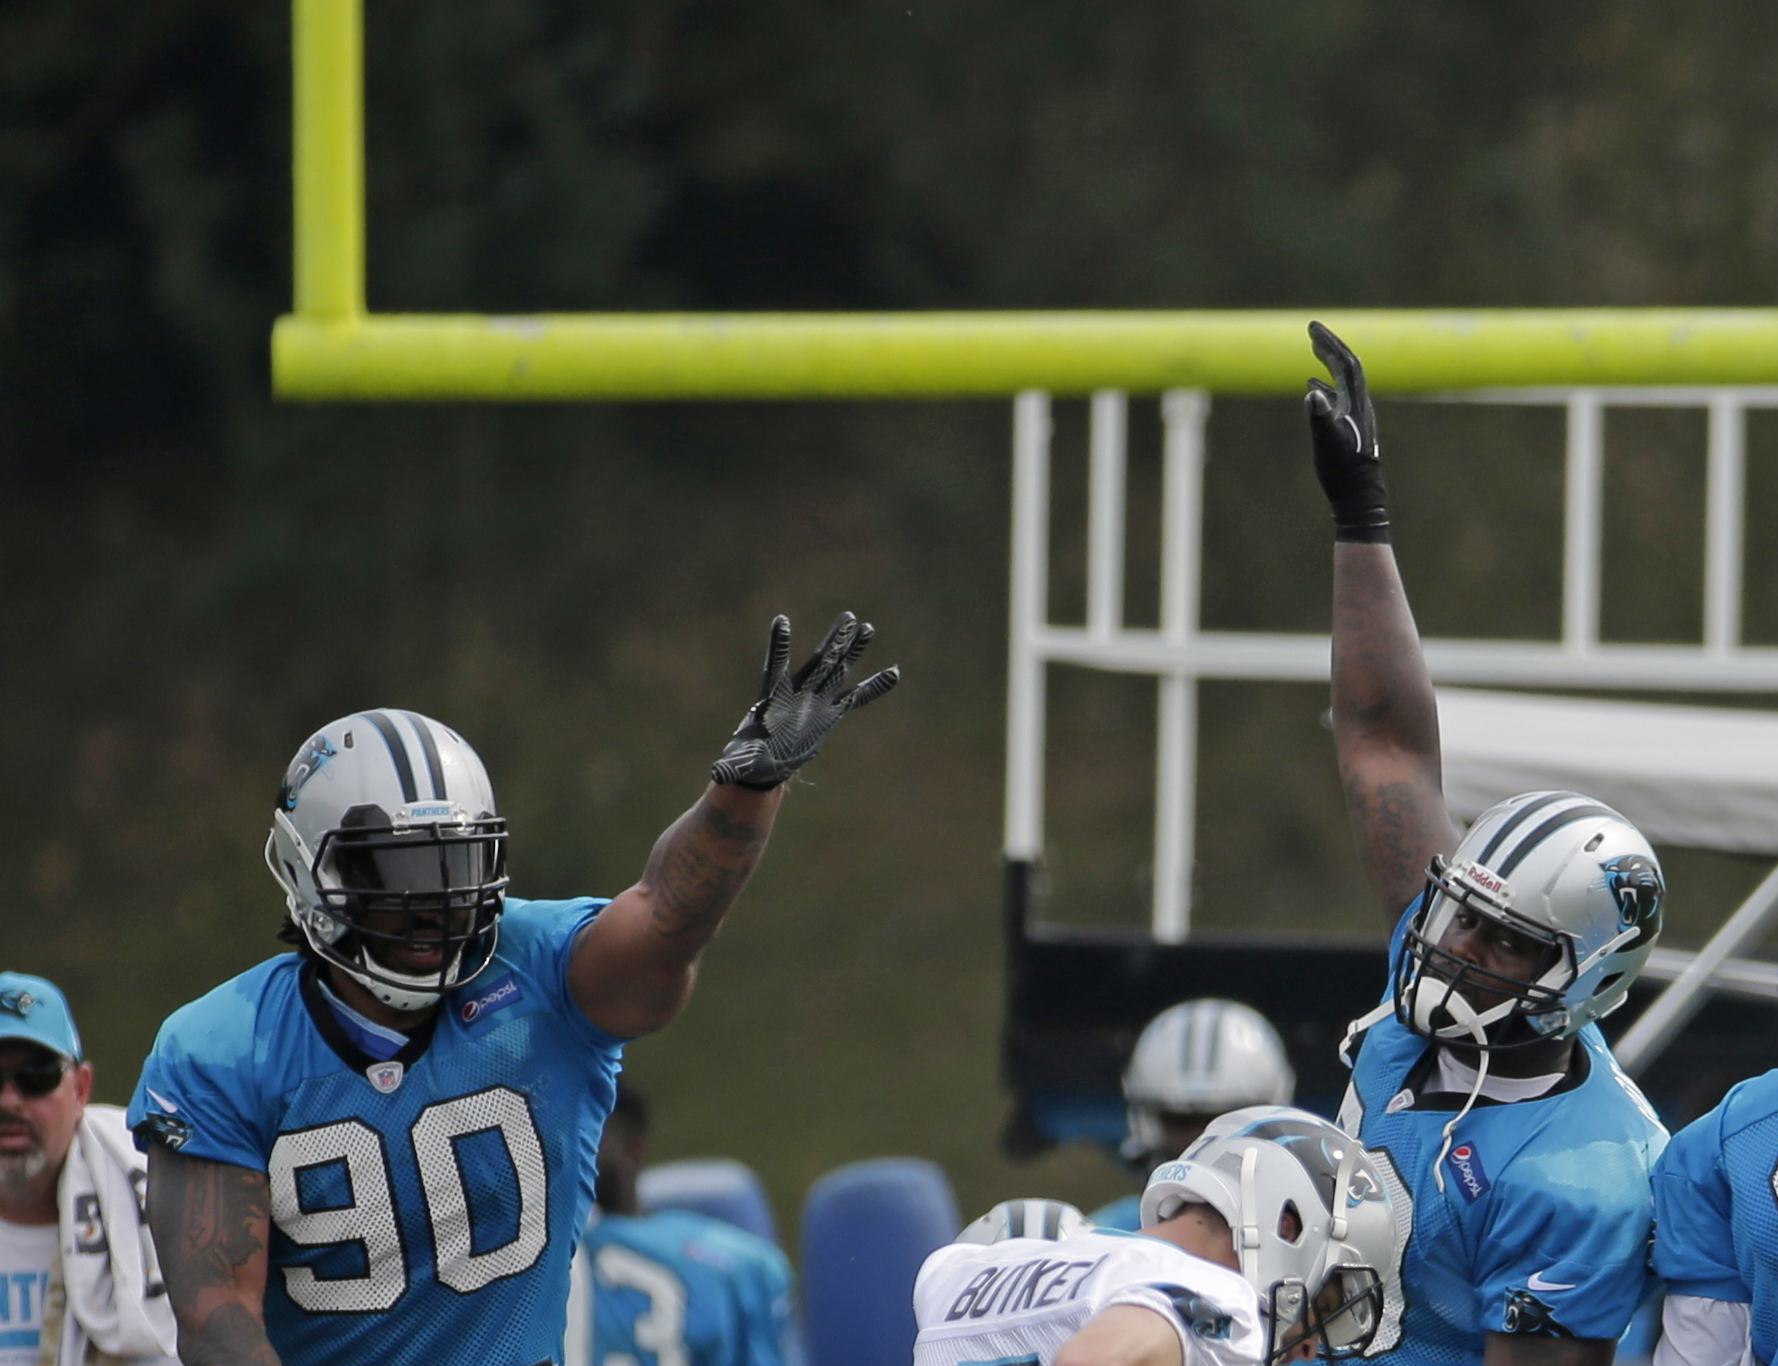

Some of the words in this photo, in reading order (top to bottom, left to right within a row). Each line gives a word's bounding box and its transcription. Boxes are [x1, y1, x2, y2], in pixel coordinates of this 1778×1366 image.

[410, 806, 451, 818] PANTHERS
[1467, 866, 1503, 893] Riddell
[480, 978, 518, 1009] pepsi
[1458, 1160, 1482, 1198] pepsi
[266, 1084, 549, 1315] 90
